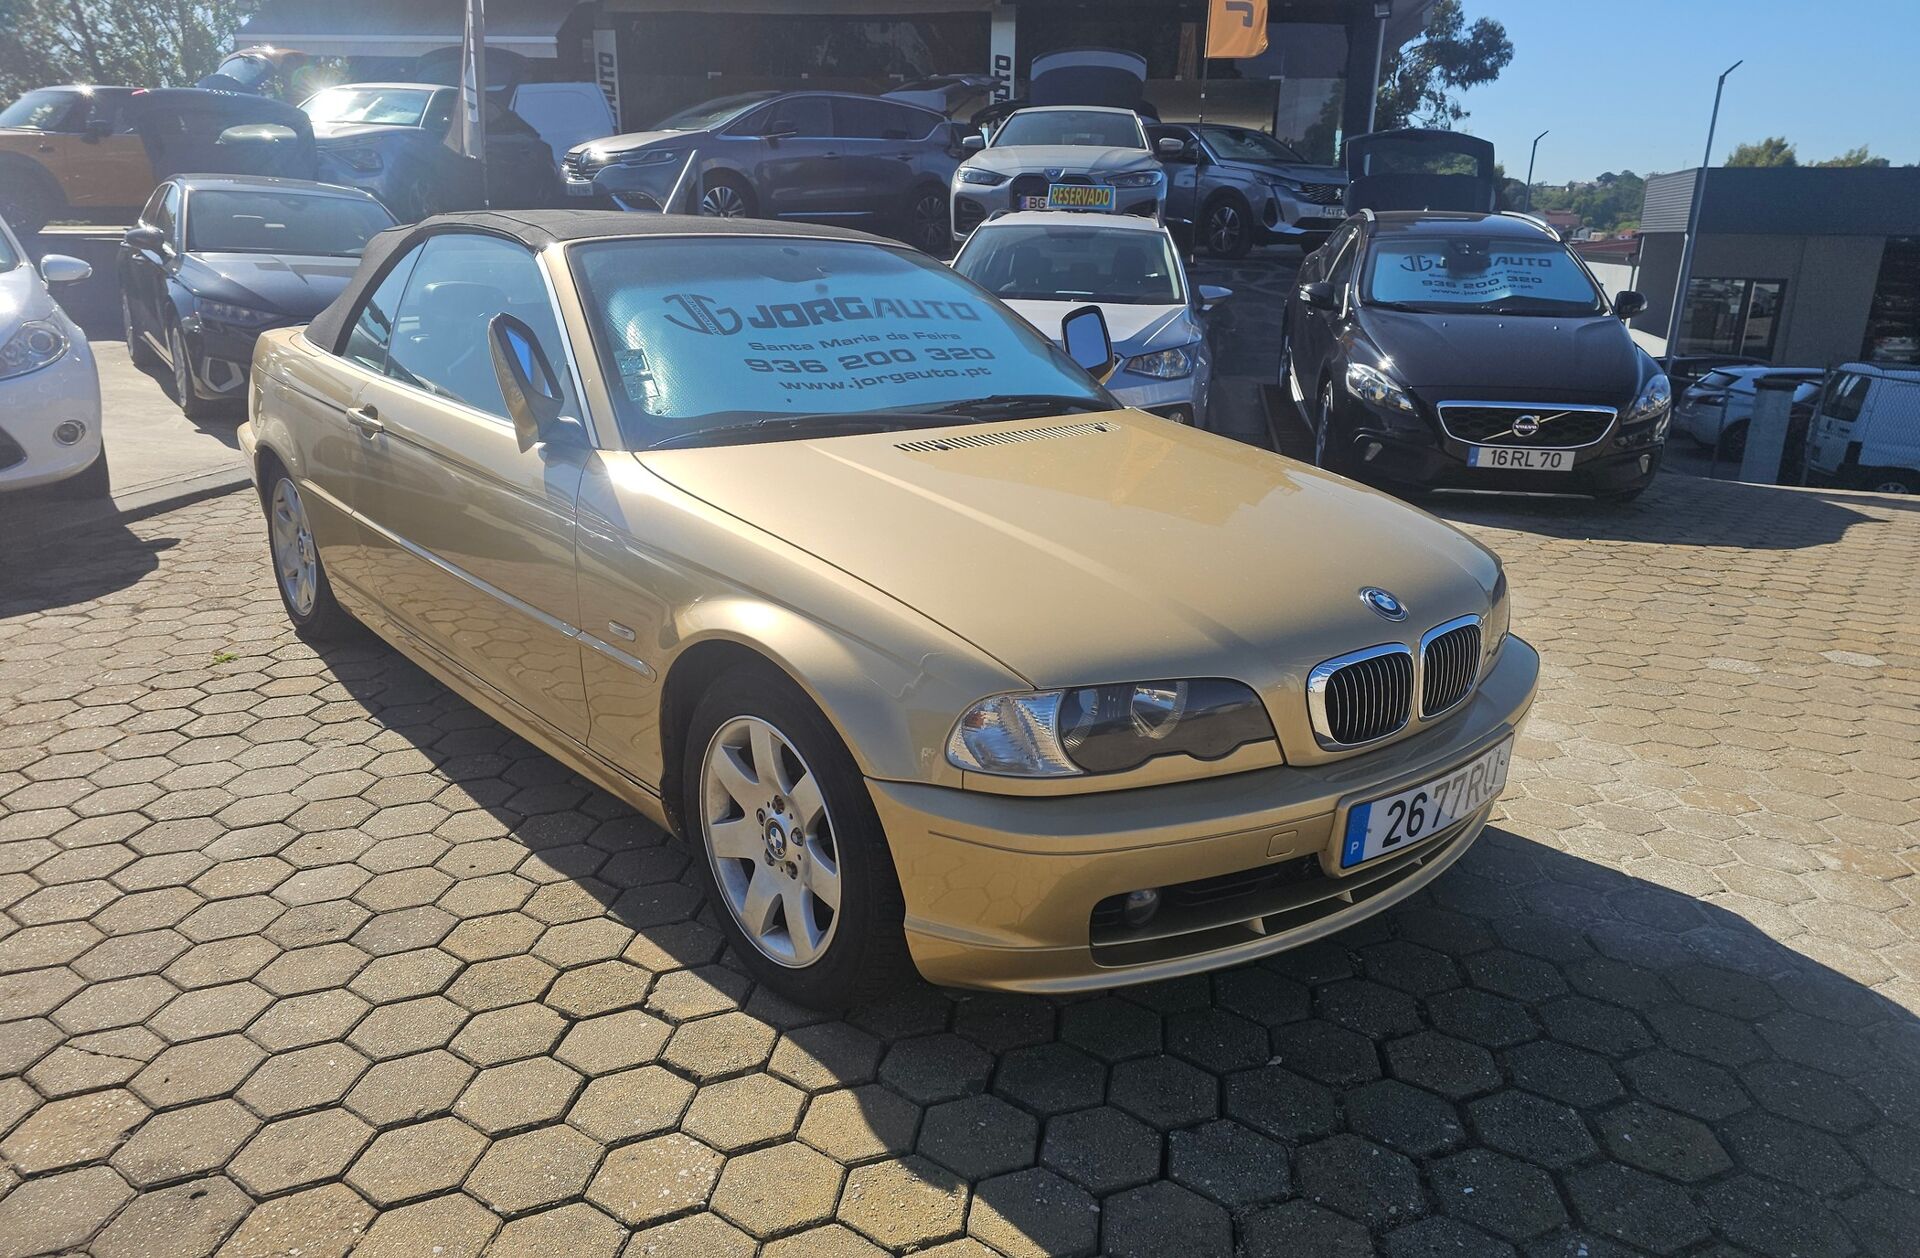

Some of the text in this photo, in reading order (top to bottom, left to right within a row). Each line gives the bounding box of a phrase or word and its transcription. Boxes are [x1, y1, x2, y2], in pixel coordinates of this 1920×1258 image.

[1052, 187, 1110, 206] RESERVADO
[748, 331, 962, 351] Santa Maria da Feira
[744, 347, 996, 374] 936 200 320
[779, 366, 992, 391] www.jorgauto.pt
[1350, 841, 1359, 855] P
